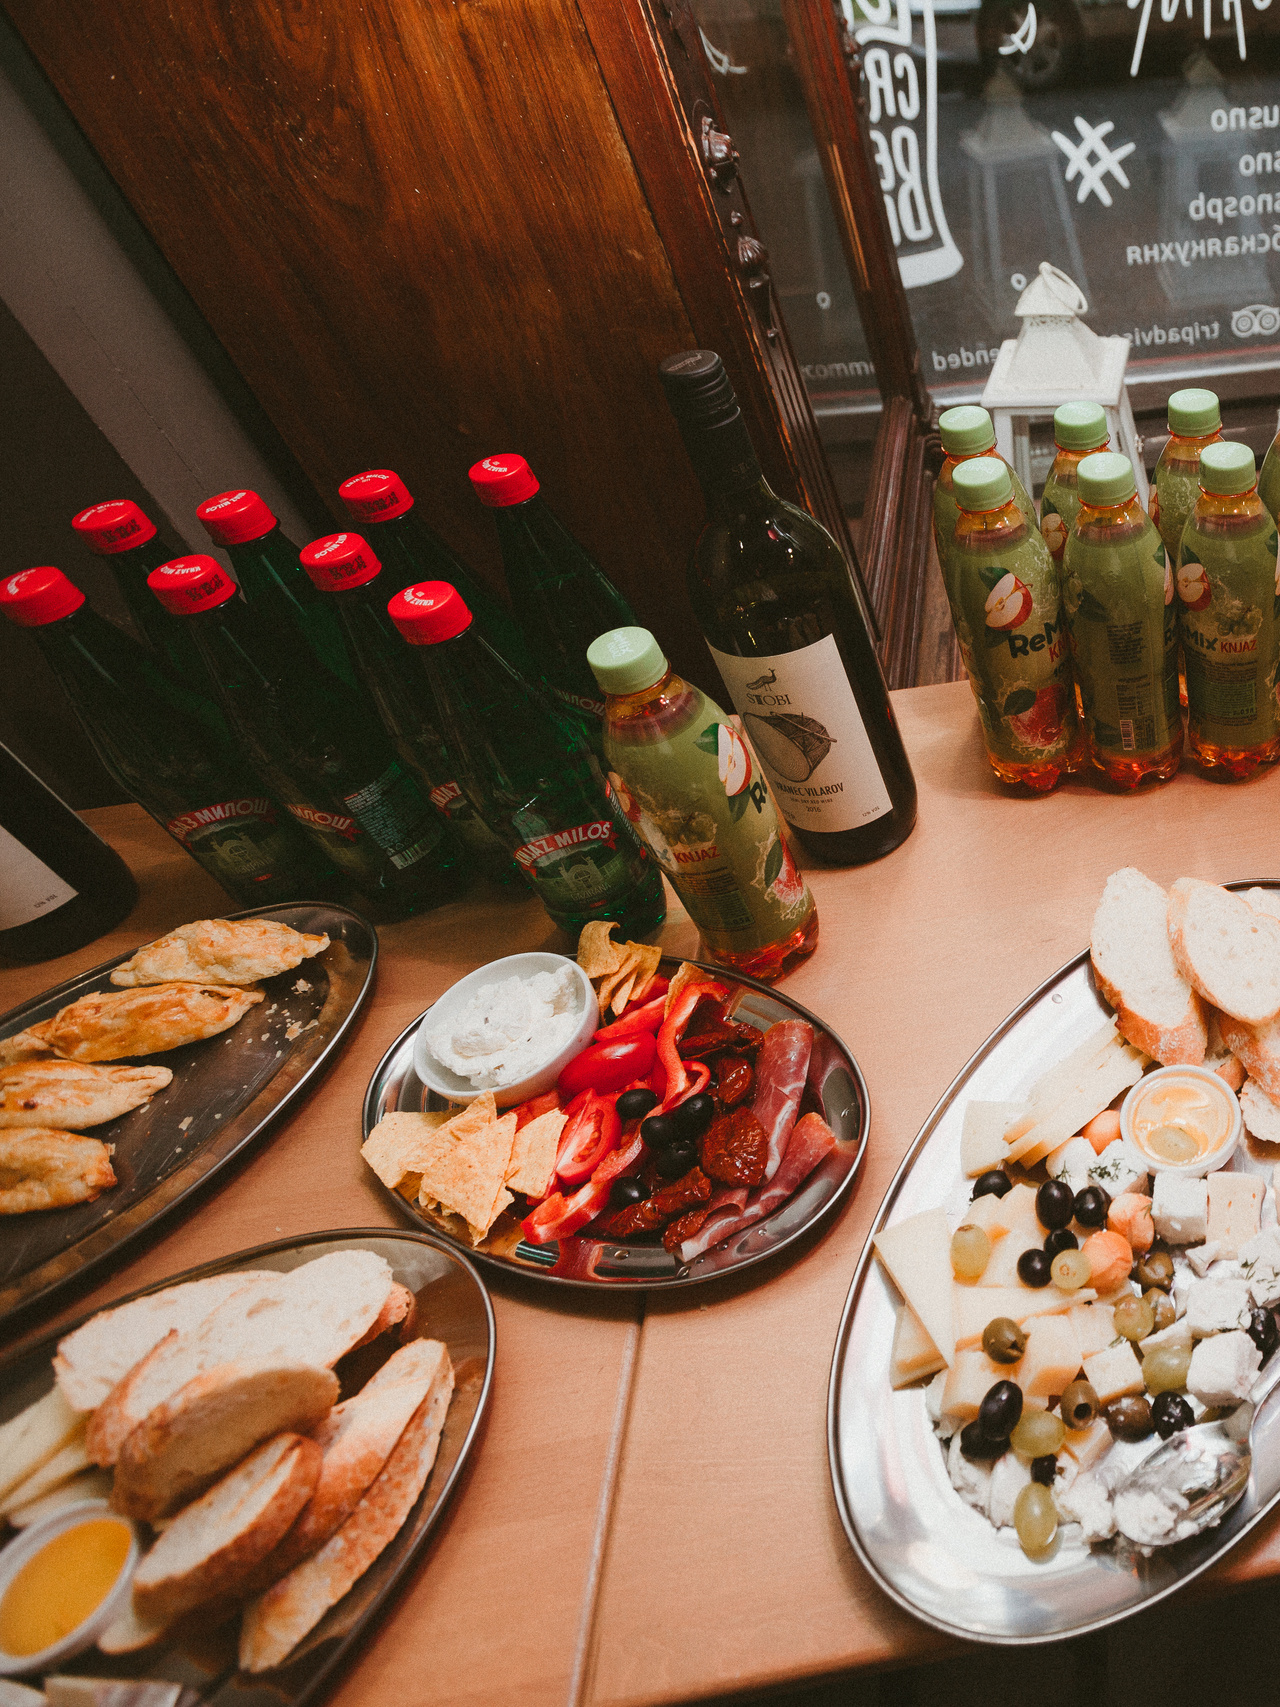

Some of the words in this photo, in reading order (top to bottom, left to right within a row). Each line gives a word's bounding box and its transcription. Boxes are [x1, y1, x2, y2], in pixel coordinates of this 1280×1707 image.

[1221, 640, 1257, 653] KNJAZ
[805, 782, 844, 797] VILAROV
[195, 800, 270, 825] МИЛОШ
[554, 822, 611, 848] MILOŠ
[673, 846, 720, 863] KNJAZ
